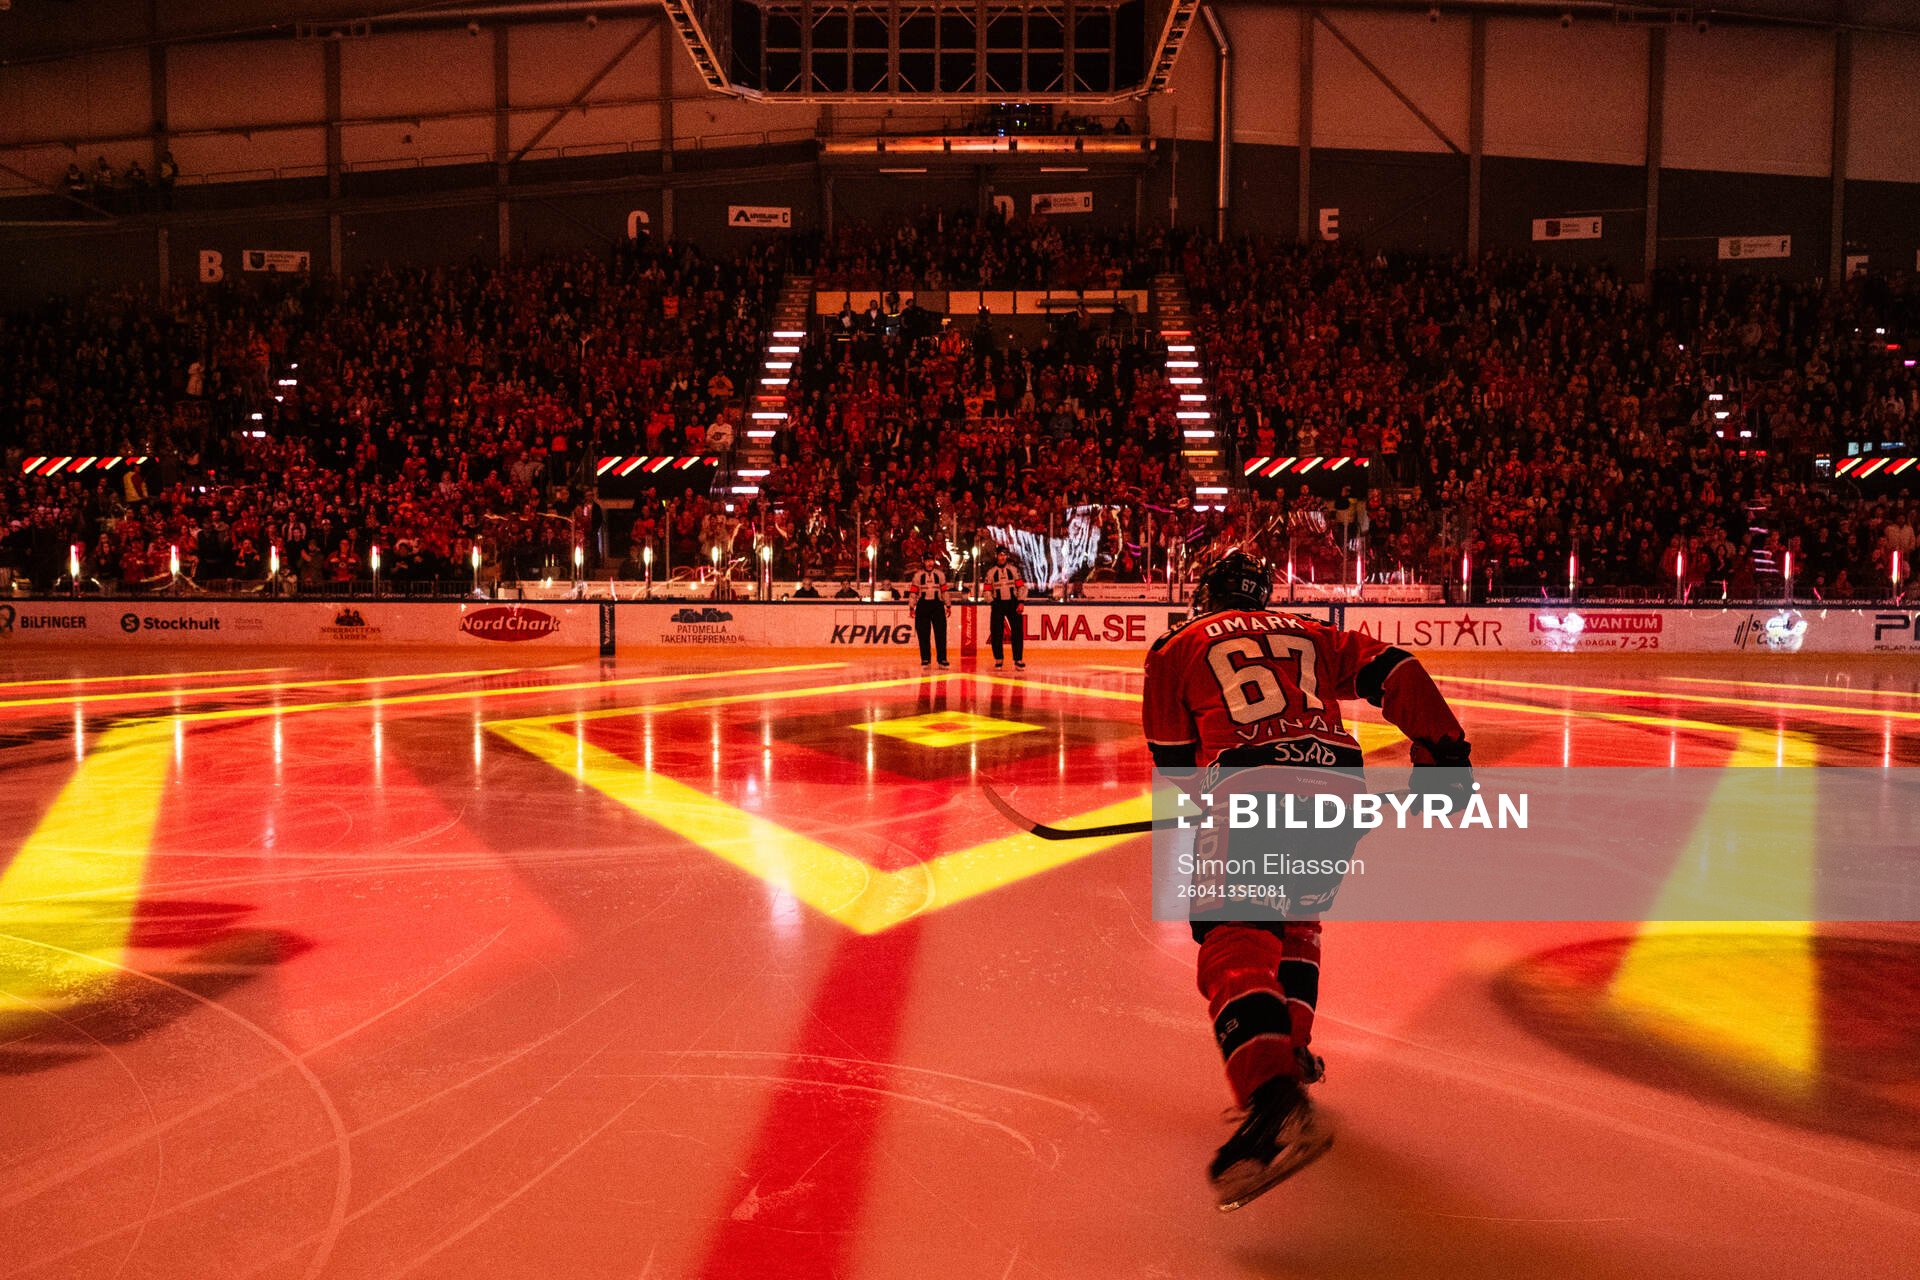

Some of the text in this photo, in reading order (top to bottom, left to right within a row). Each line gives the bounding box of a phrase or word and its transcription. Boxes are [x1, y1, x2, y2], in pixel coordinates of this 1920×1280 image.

[627, 210, 650, 240] C
[1319, 208, 1340, 241] E
[200, 250, 224, 283] B
[1241, 578, 1256, 593] 67
[143, 616, 220, 630] Stockhult
[677, 625, 727, 634] PATOMELLA
[830, 624, 912, 644] KPMG
[1204, 615, 1305, 637] OMARK
[1358, 613, 1502, 646] ALLSTAR
[661, 634, 737, 644] TAKENTREPRENAD
[1585, 639, 1617, 647] DAGAR
[1620, 636, 1659, 648] 7-23
[1207, 634, 1326, 725] 67
[1274, 742, 1337, 766] SSAB
